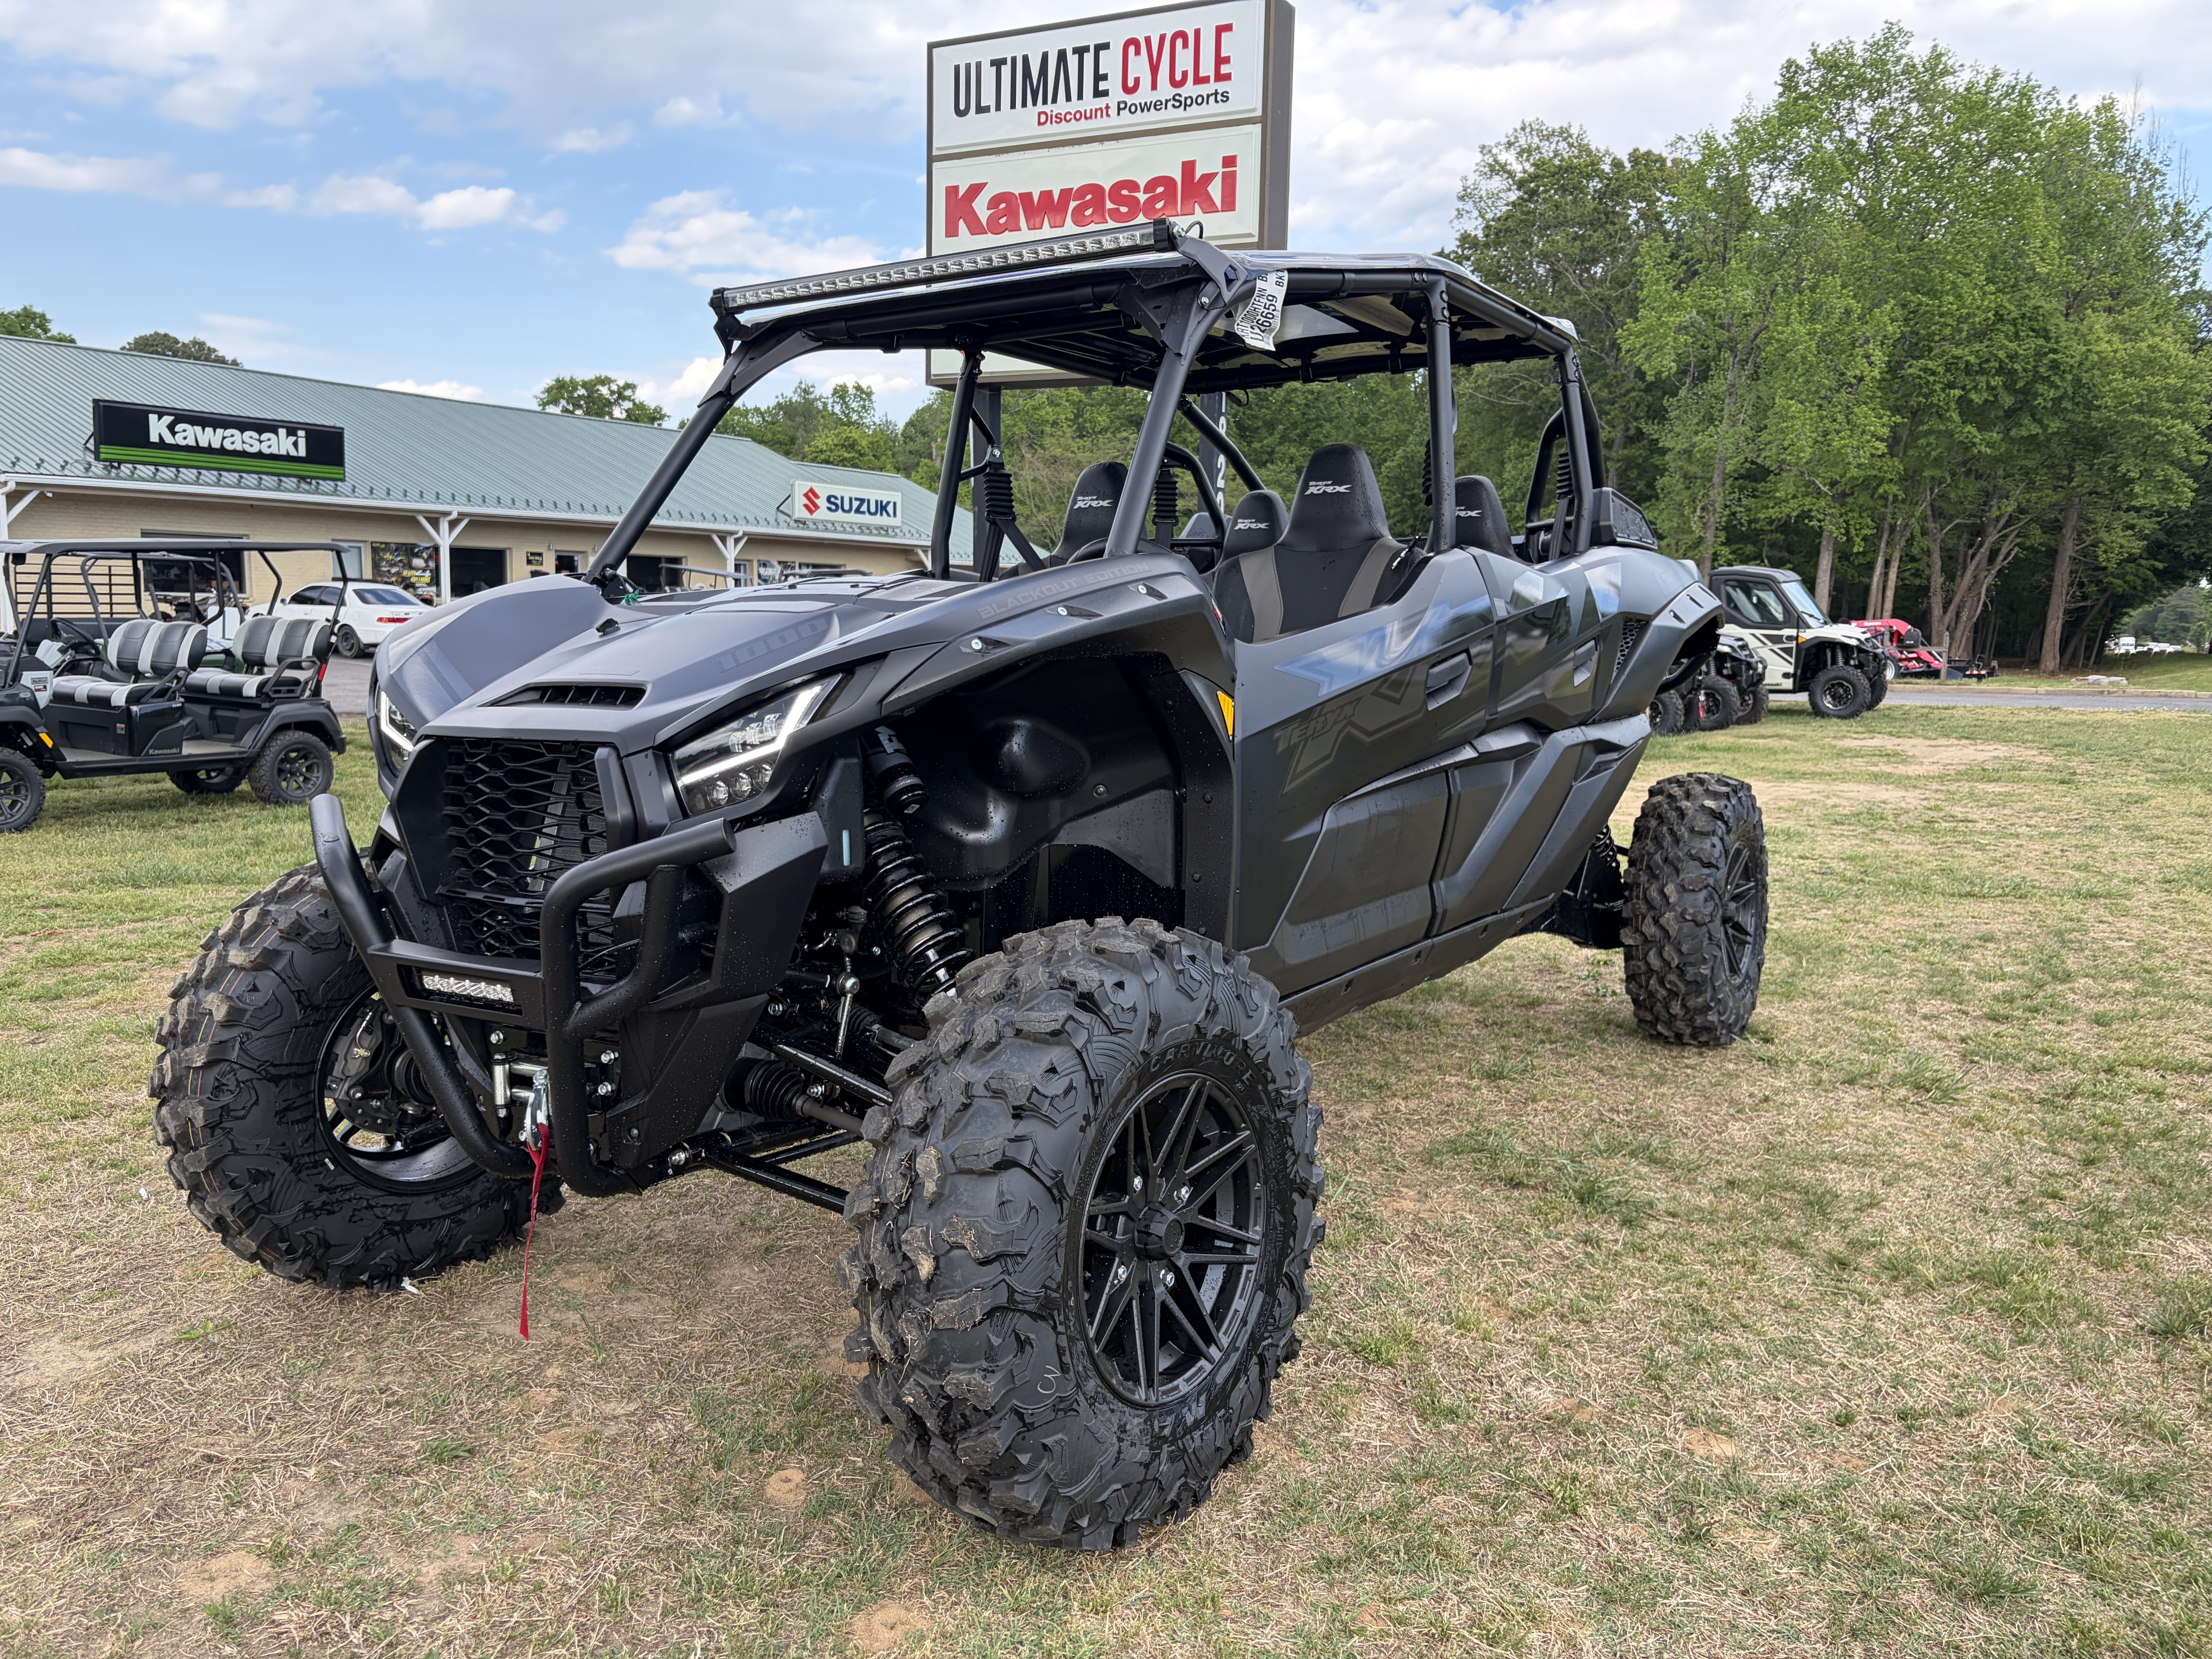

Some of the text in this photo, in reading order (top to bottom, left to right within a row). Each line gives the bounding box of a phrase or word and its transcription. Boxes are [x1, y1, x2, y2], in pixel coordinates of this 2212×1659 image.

[953, 22, 1234, 118] ULTIMATE CYCLE
[1037, 88, 1230, 127] Discount PowerSports
[945, 155, 1238, 238] Kawasaki
[1250, 294, 1278, 342] U26659
[148, 413, 307, 457] Kawasaki
[826, 494, 897, 518] SUZUKI
[1073, 500, 1113, 509] KRX
[1304, 485, 1352, 495] KRX
[977, 562, 1150, 621] BLACKOUT EDITION
[716, 618, 828, 671] 1000
